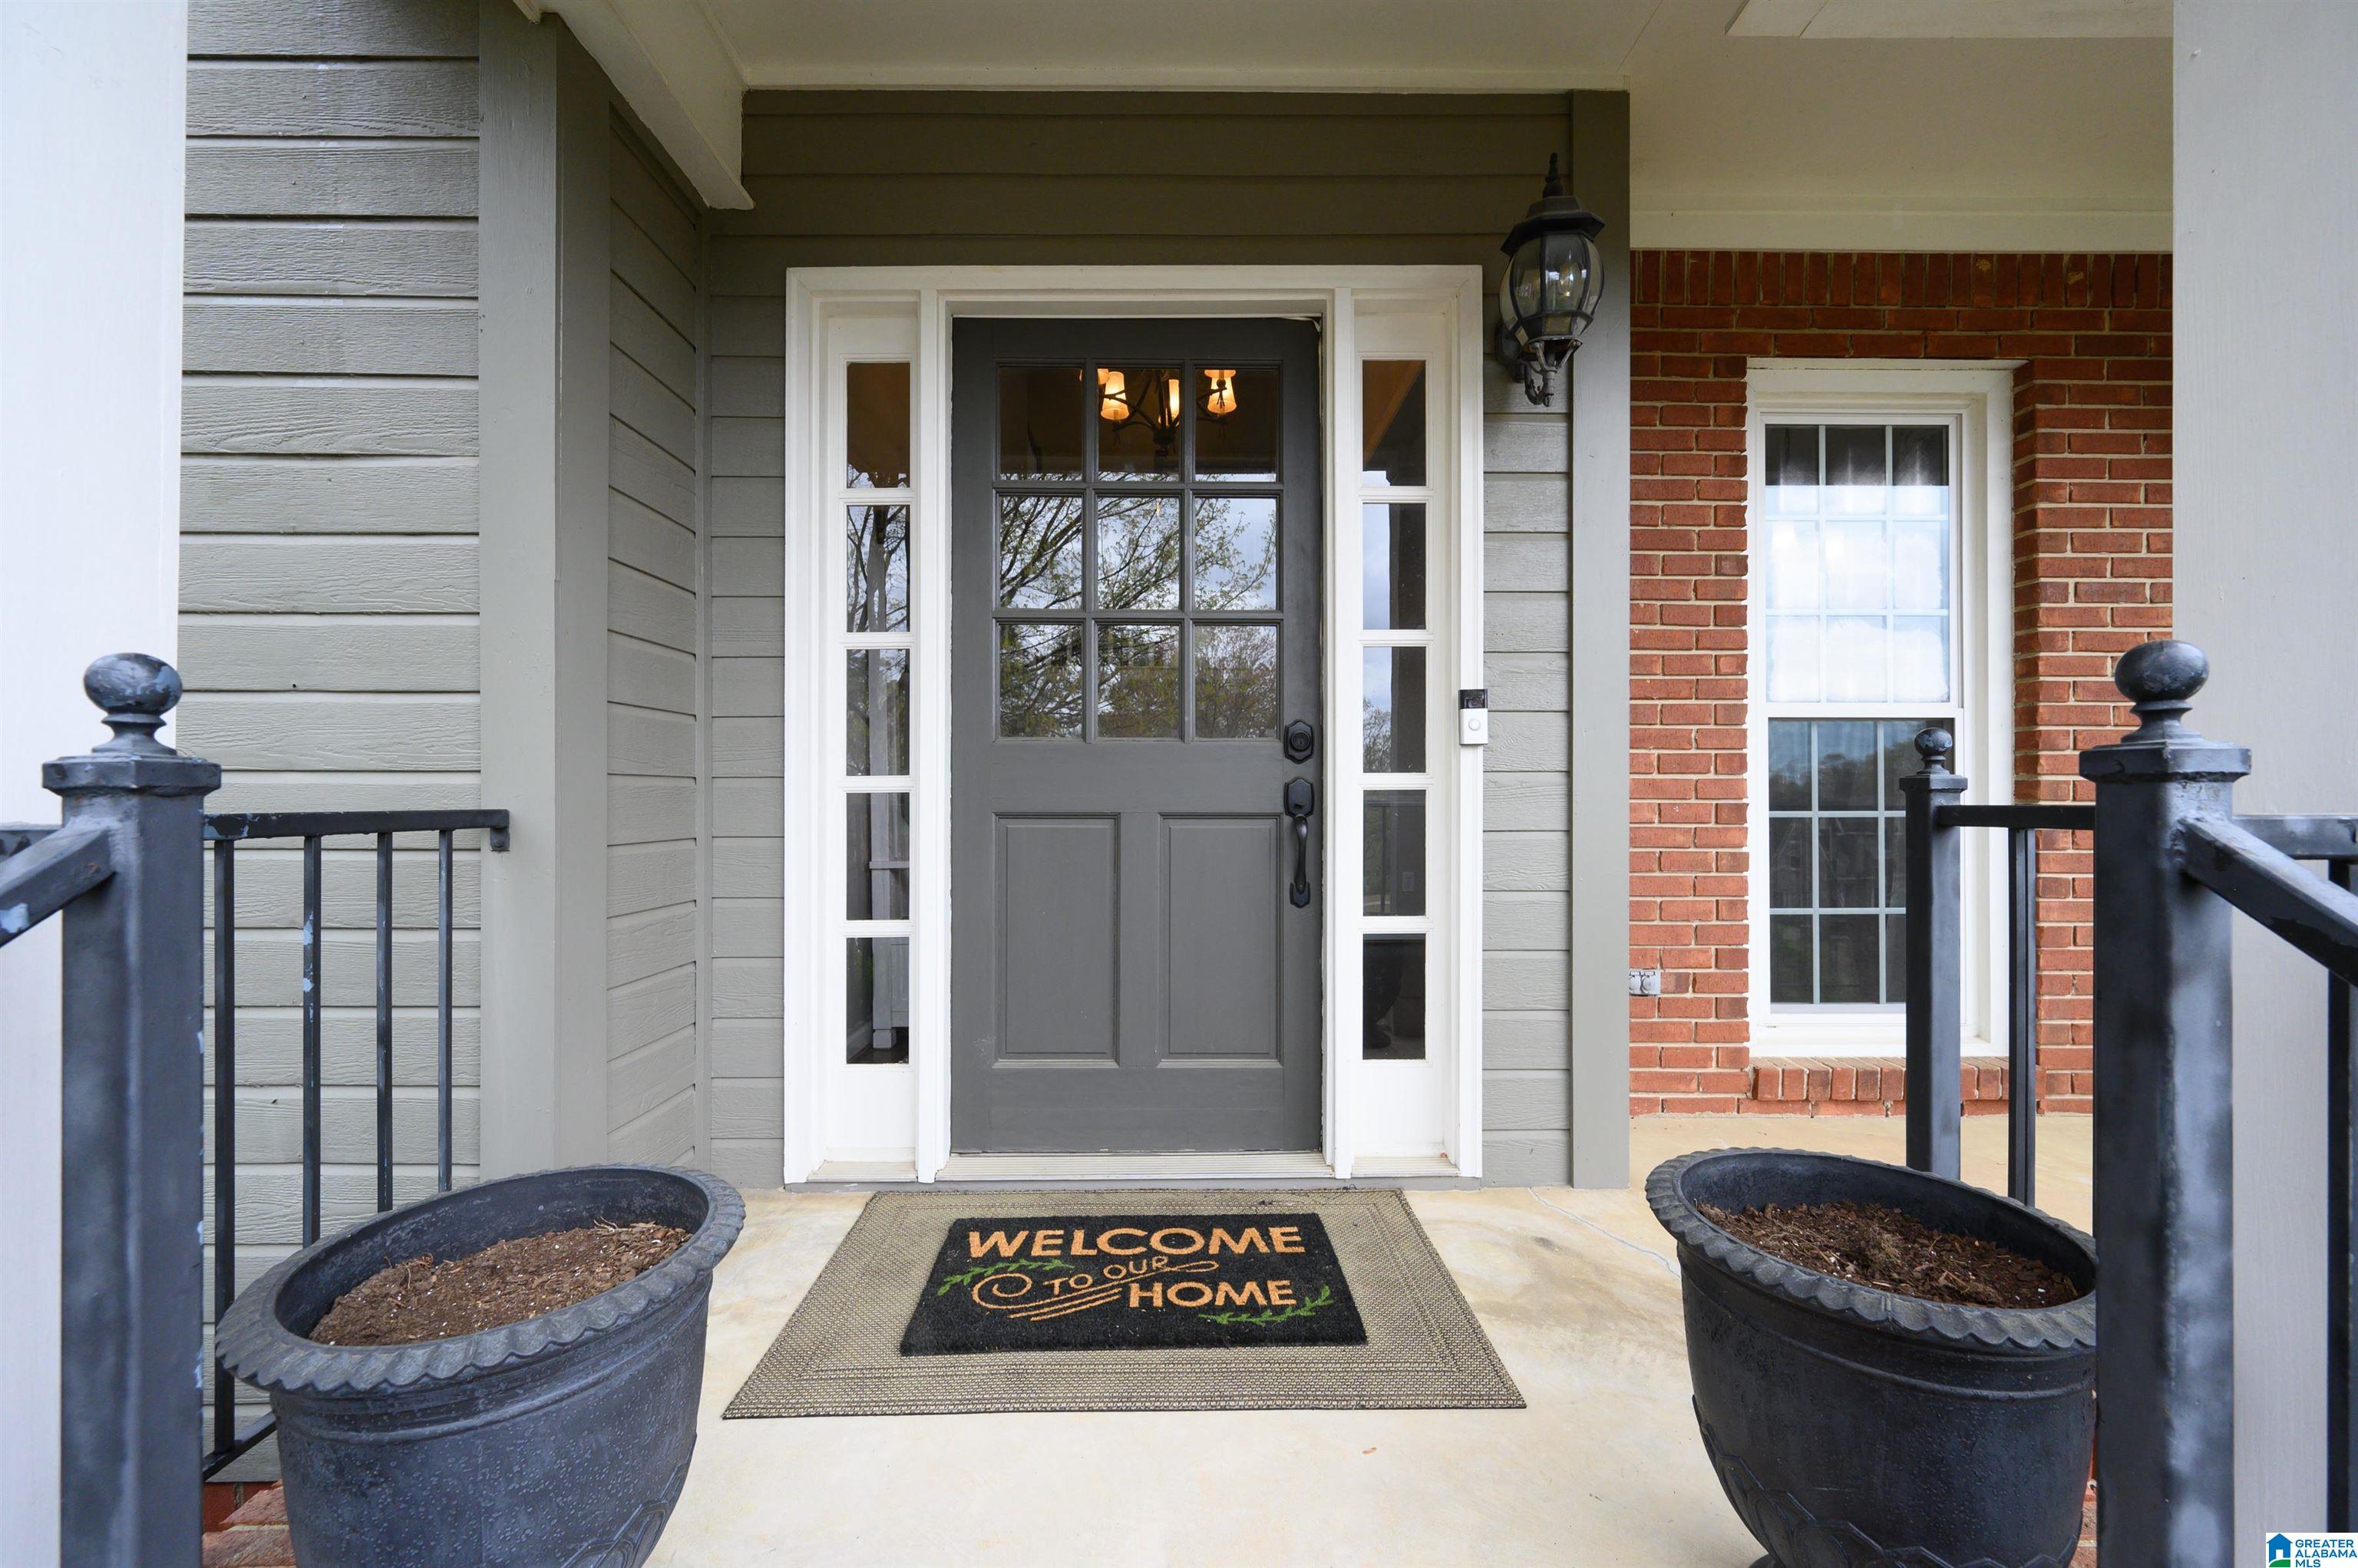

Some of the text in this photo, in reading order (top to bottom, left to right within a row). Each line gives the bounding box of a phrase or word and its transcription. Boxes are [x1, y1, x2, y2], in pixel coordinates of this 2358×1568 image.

[968, 1226, 1306, 1259] WELCOME
[1043, 1255, 1169, 1295] TO OUR
[1128, 1279, 1297, 1309] HOME
